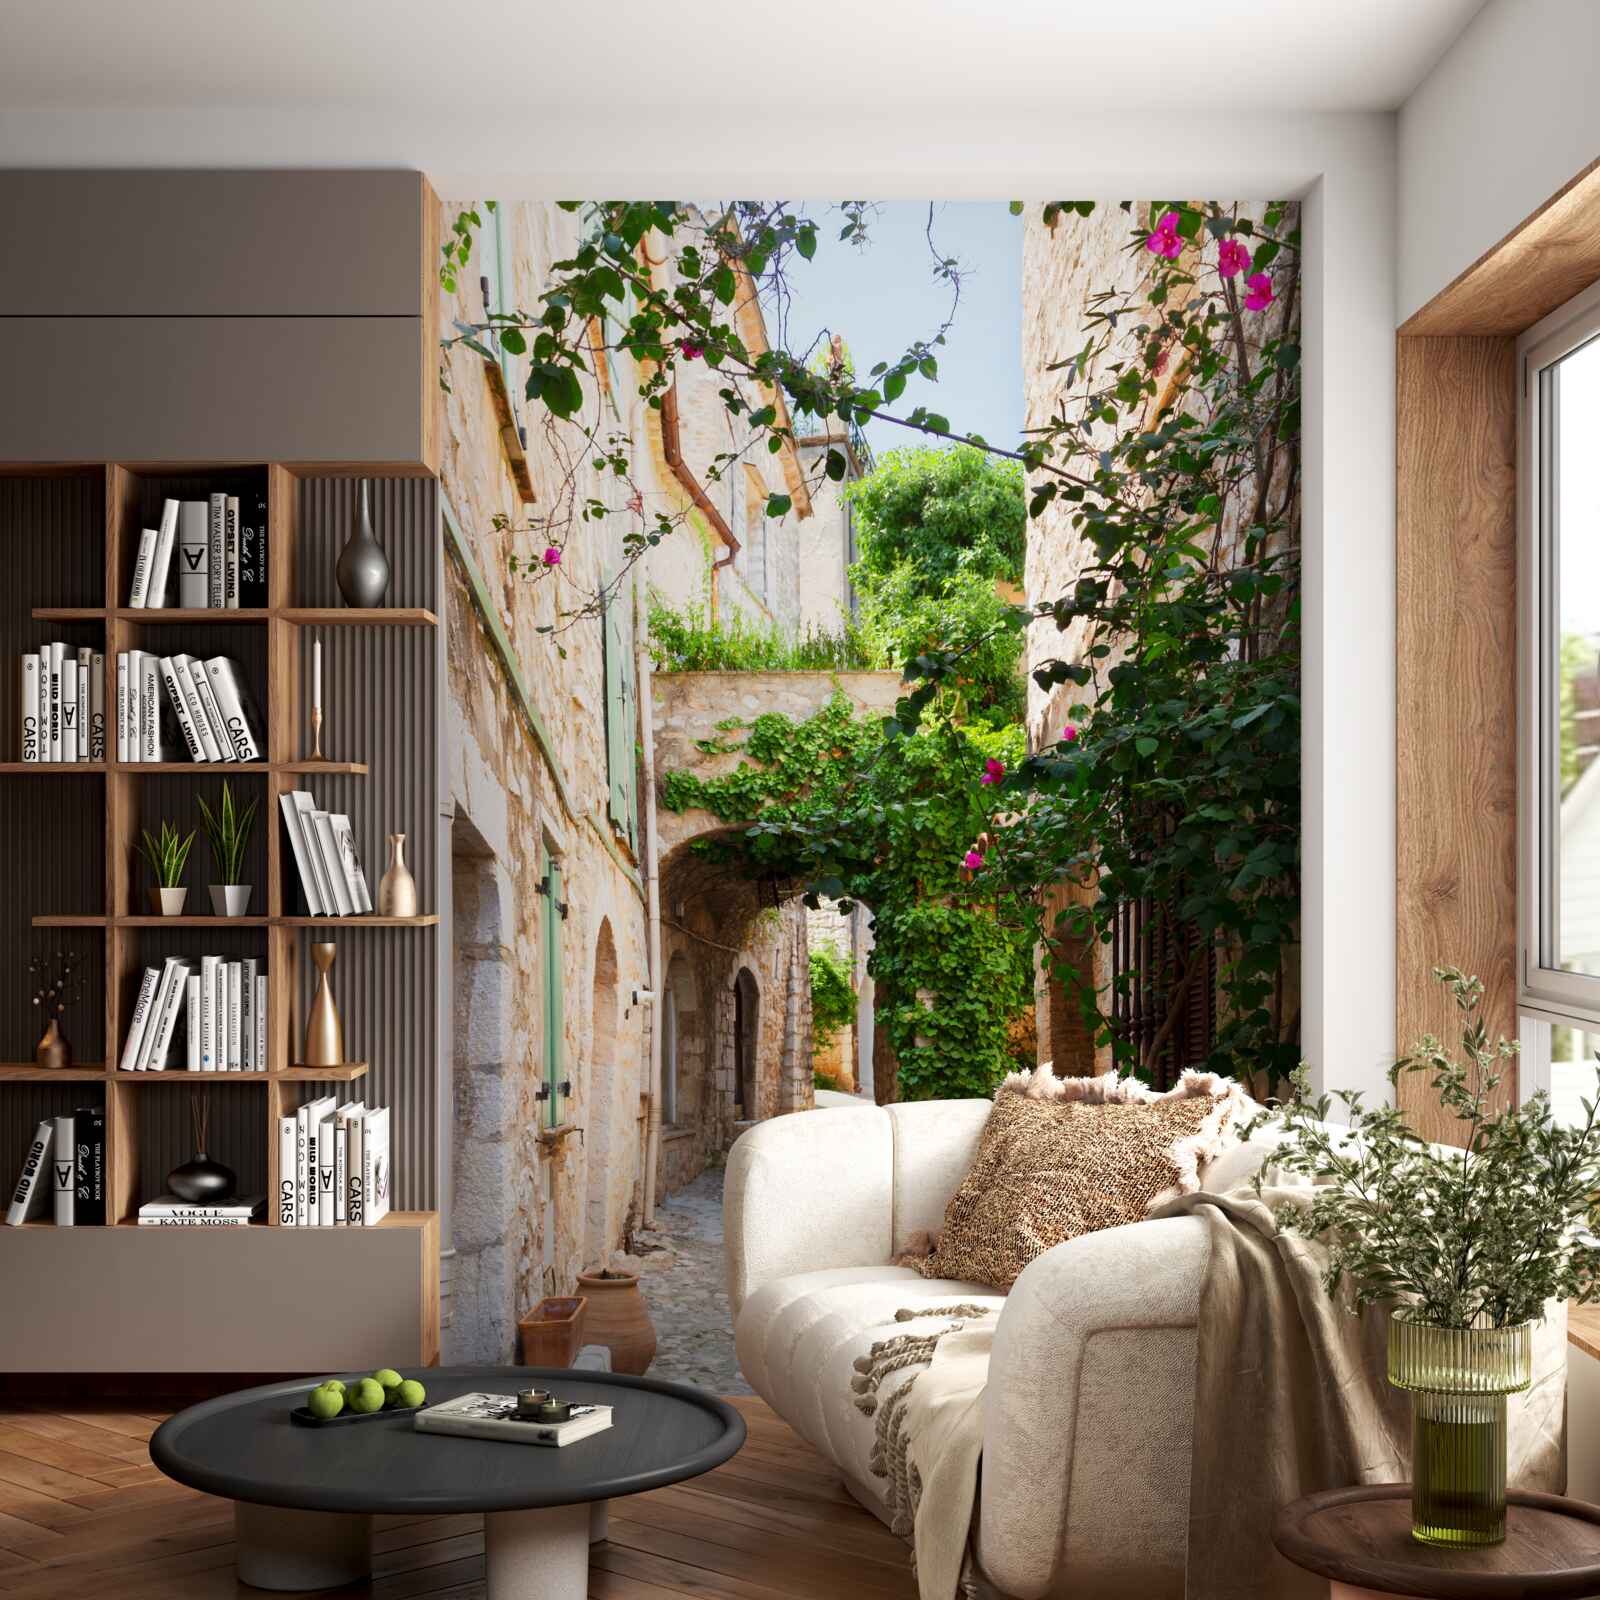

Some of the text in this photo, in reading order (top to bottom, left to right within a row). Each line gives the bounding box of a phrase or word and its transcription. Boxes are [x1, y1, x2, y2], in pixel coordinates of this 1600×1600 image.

[213, 522, 222, 554] WALKER
[213, 556, 222, 580] STORY
[24, 716, 36, 760] CARS
[92, 713, 104, 758] CARS
[166, 676, 199, 756] GYPSET LIVING
[193, 710, 208, 737] HOUSES
[227, 717, 253, 760] CARS
[14, 1141, 44, 1204] WILD WORLD
[281, 1180, 293, 1224] CARS
[350, 1177, 361, 1222] CARS
